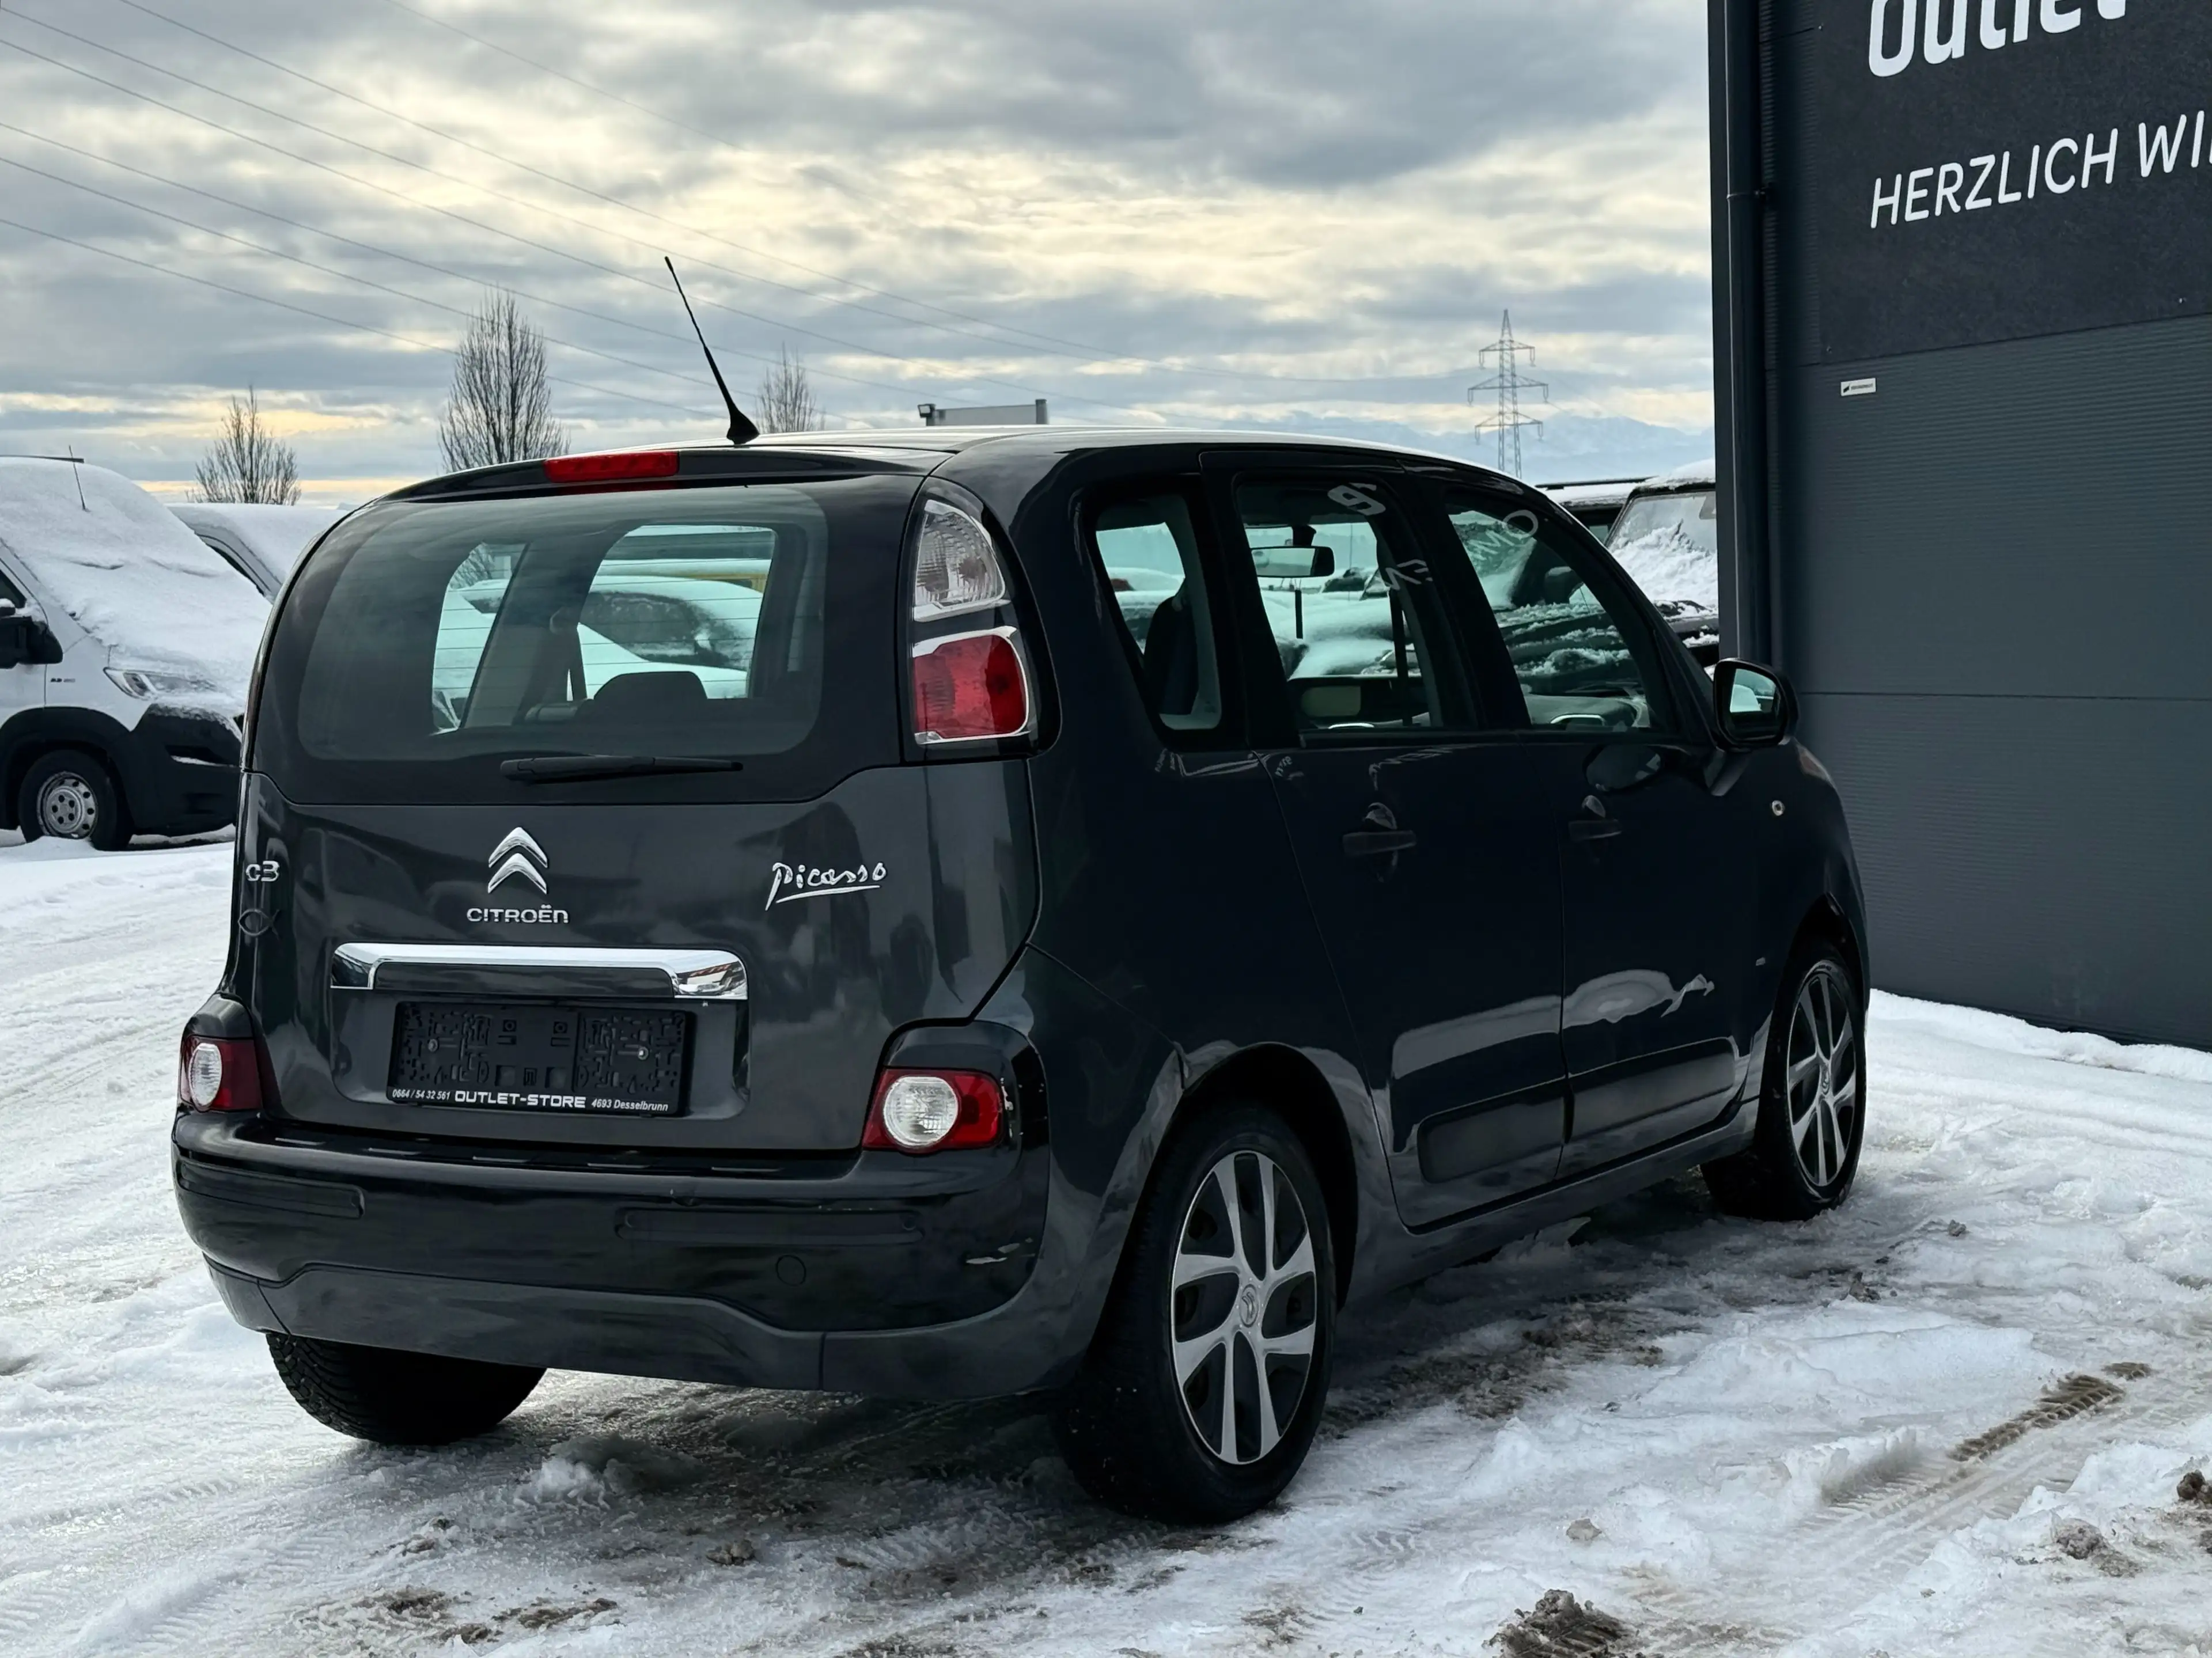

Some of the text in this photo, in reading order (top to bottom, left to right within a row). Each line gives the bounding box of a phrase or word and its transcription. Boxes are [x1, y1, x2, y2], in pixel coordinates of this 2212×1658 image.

[1868, 0, 2126, 77] Out
[1870, 110, 2212, 229] HERZLICH WI
[764, 862, 887, 912] Picasso
[415, 1090, 425, 1099] 54
[426, 1090, 435, 1099] 32
[437, 1091, 450, 1101] 561
[454, 1090, 586, 1109] OUTLET-STORE
[591, 1098, 612, 1109] 4693
[613, 1099, 668, 1111] Desselbrunn
